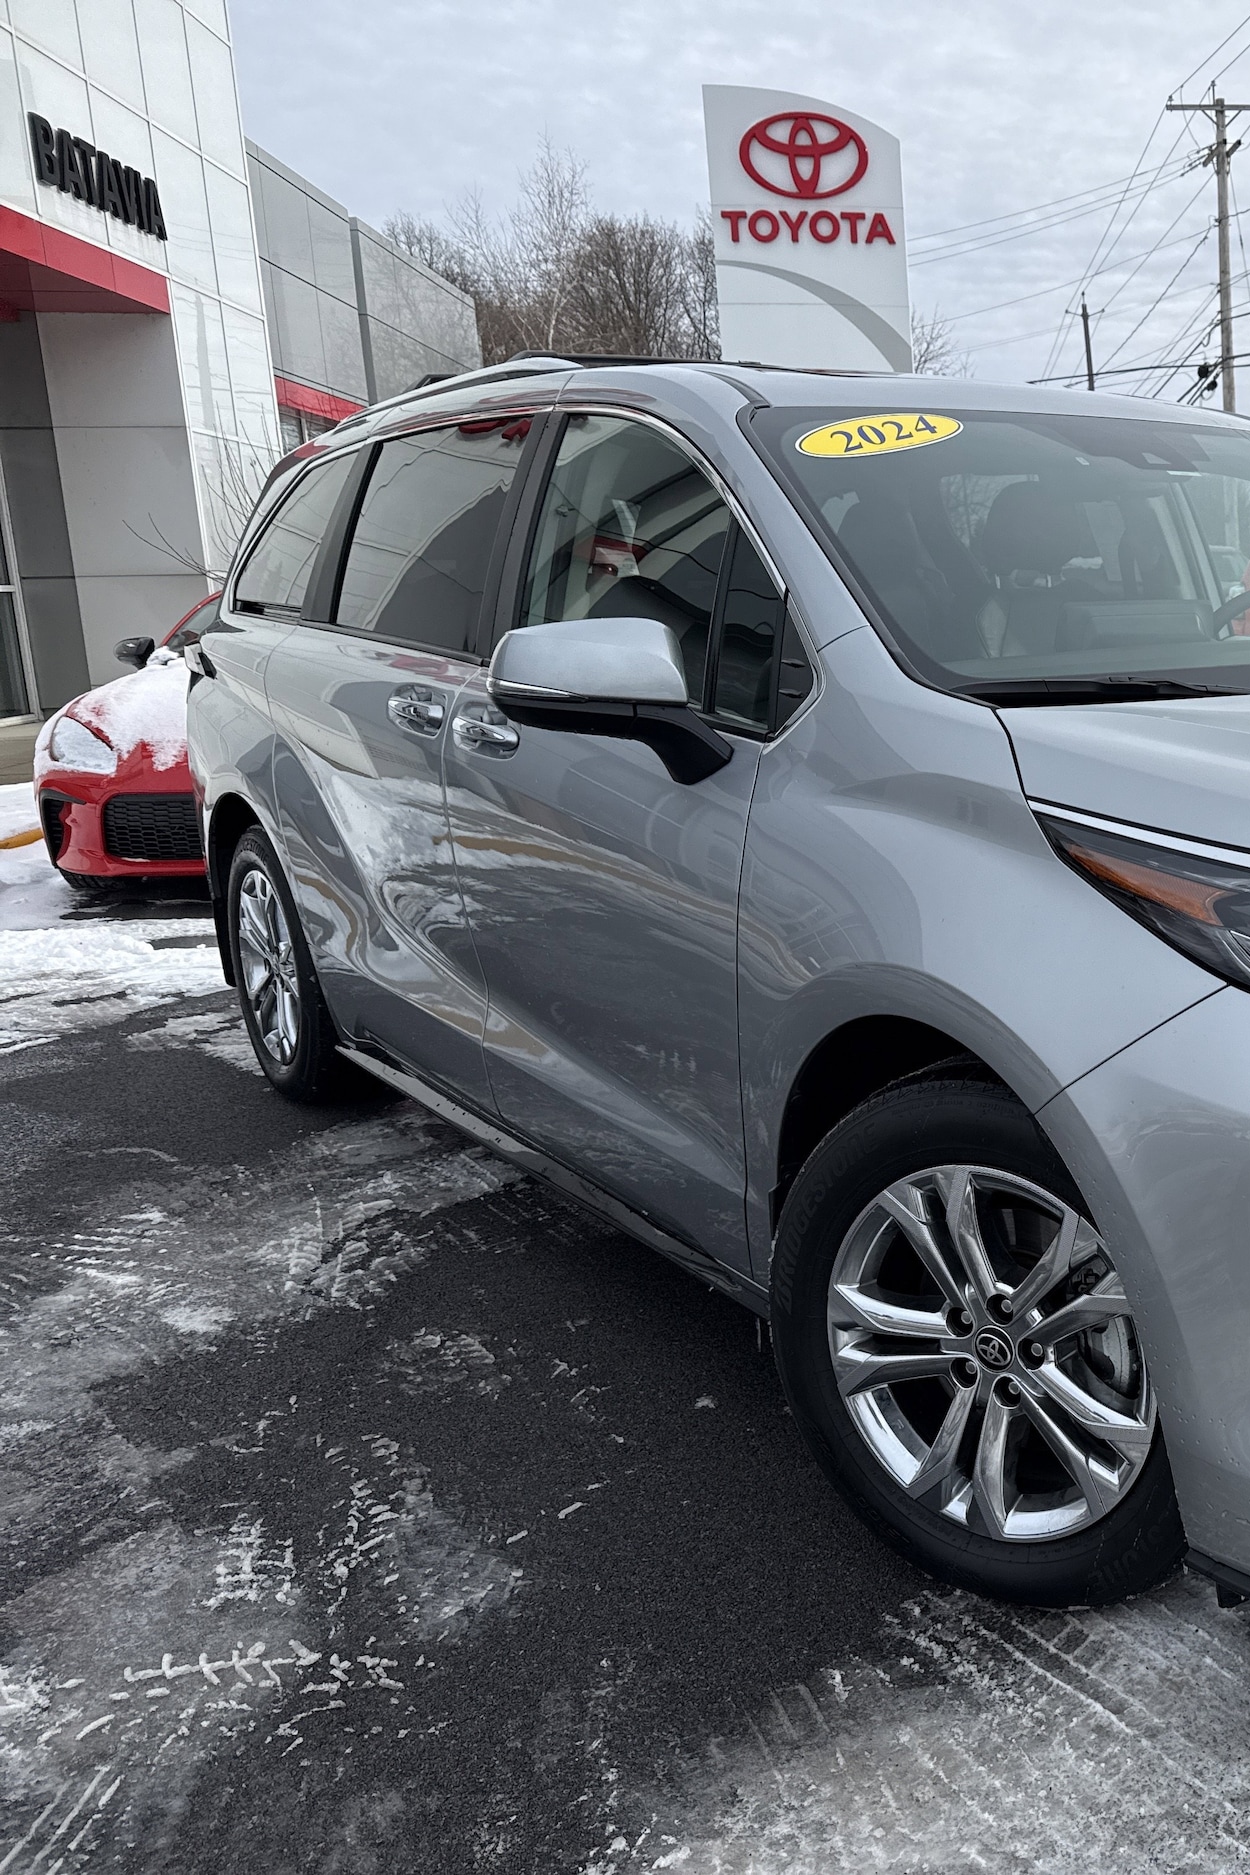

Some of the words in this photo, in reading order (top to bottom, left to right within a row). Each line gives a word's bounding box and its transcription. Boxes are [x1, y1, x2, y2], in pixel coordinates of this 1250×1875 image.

[27, 111, 168, 241] BATAVIA
[720, 209, 897, 246] TOYOTA
[830, 415, 938, 454] 2024
[774, 1122, 881, 1318] BRIDGESTONE
